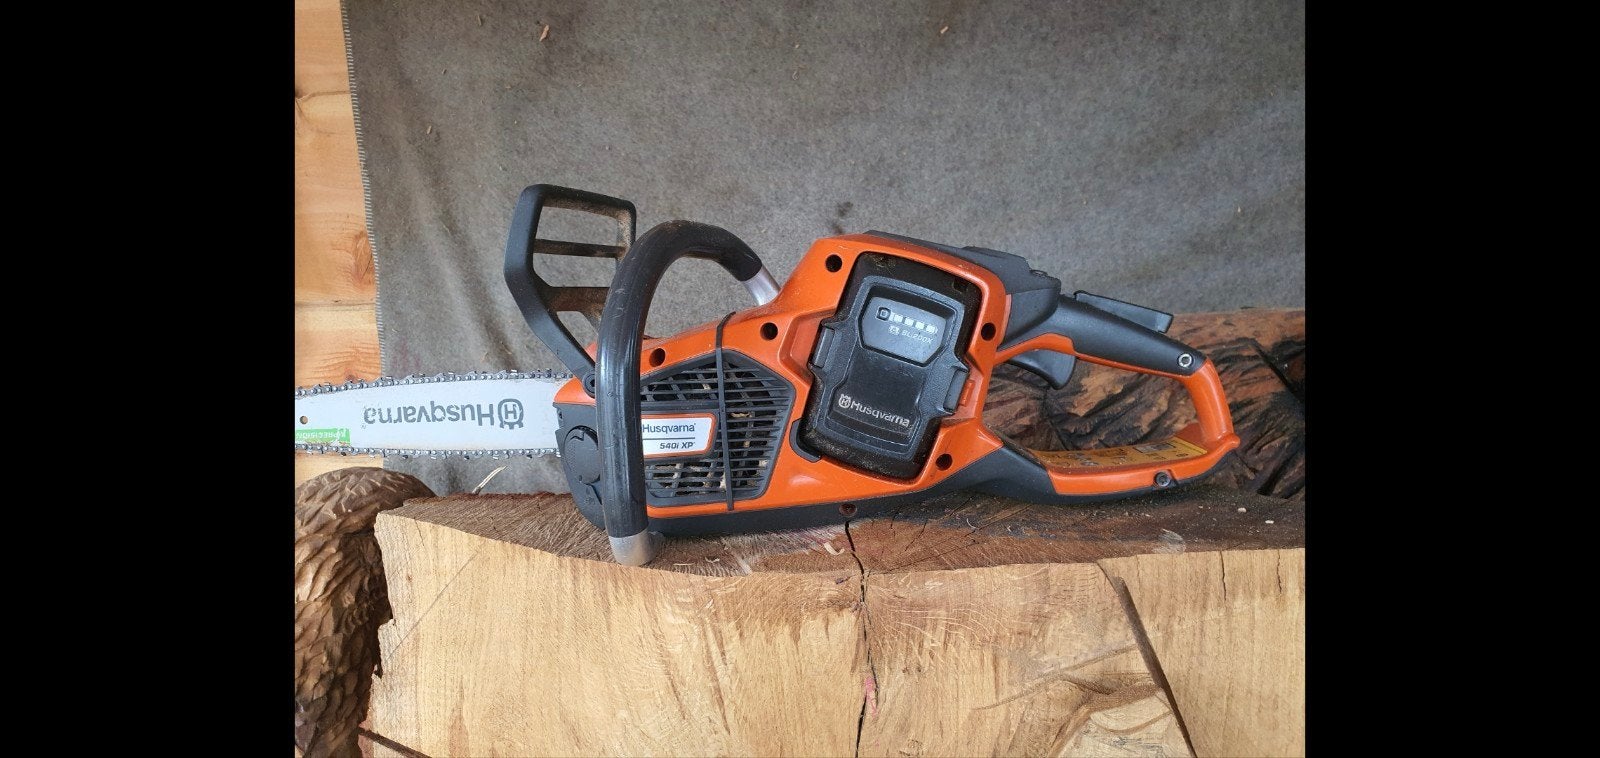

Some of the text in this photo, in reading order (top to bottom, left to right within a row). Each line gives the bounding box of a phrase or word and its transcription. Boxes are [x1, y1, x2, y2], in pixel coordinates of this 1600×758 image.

[363, 401, 494, 427] Husqvarna
[850, 401, 910, 427] Husqvarna
[642, 423, 696, 434] Husqvarna
[659, 442, 679, 450] 540i
